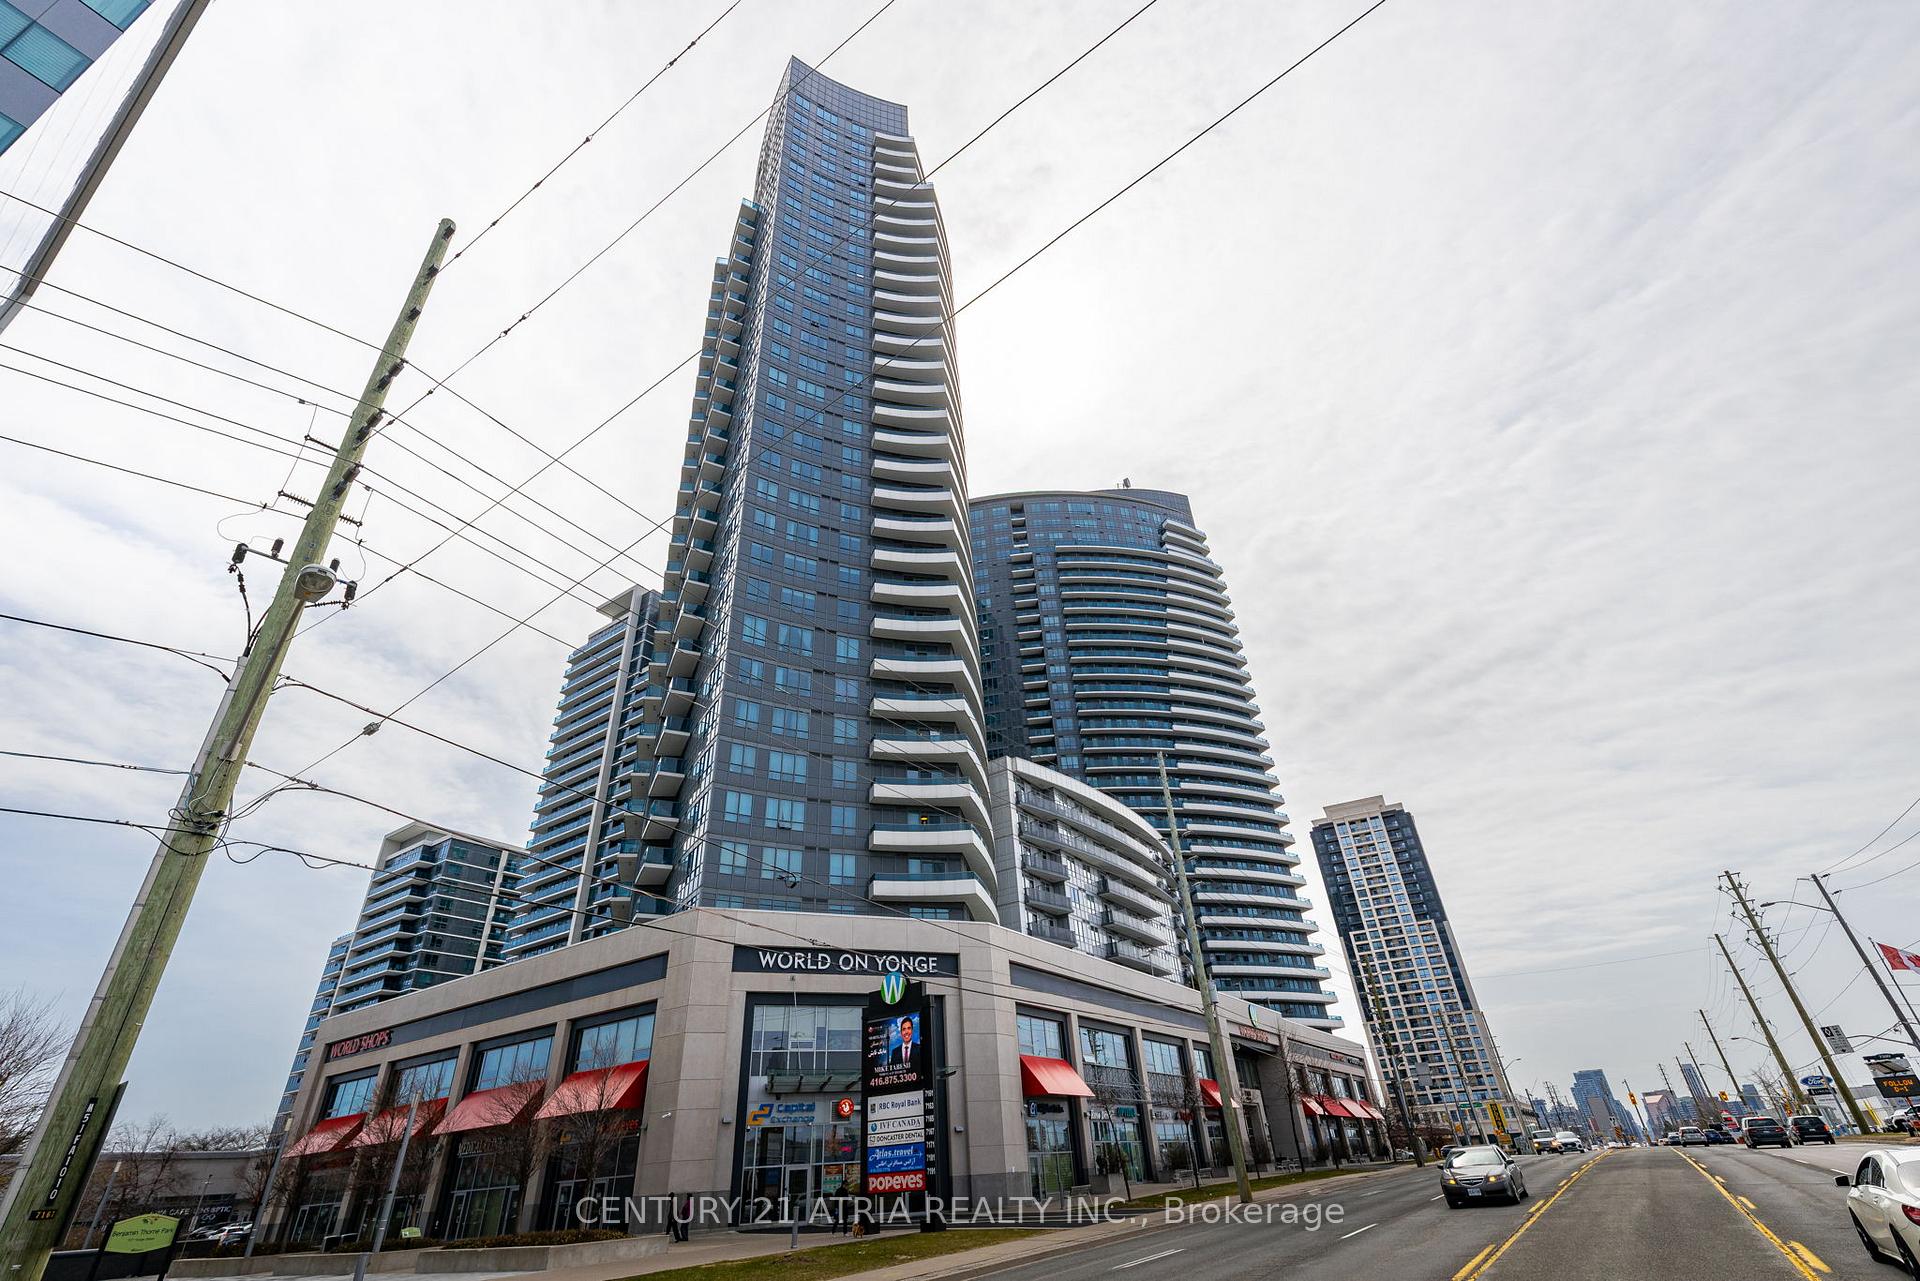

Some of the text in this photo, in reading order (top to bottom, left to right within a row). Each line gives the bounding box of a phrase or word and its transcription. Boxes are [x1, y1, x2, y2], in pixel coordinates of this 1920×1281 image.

[758, 951, 938, 974] WORLD ON YONGE
[330, 1030, 391, 1059] WORLD SHOPS
[869, 1072, 917, 1087] 416.875.3300
[1883, 1079, 1914, 1087] FOLLOW
[878, 1098, 922, 1110] RBC Royal Bank
[879, 1118, 921, 1130] IVF CANADA
[877, 1133, 904, 1142] DONCASTER
